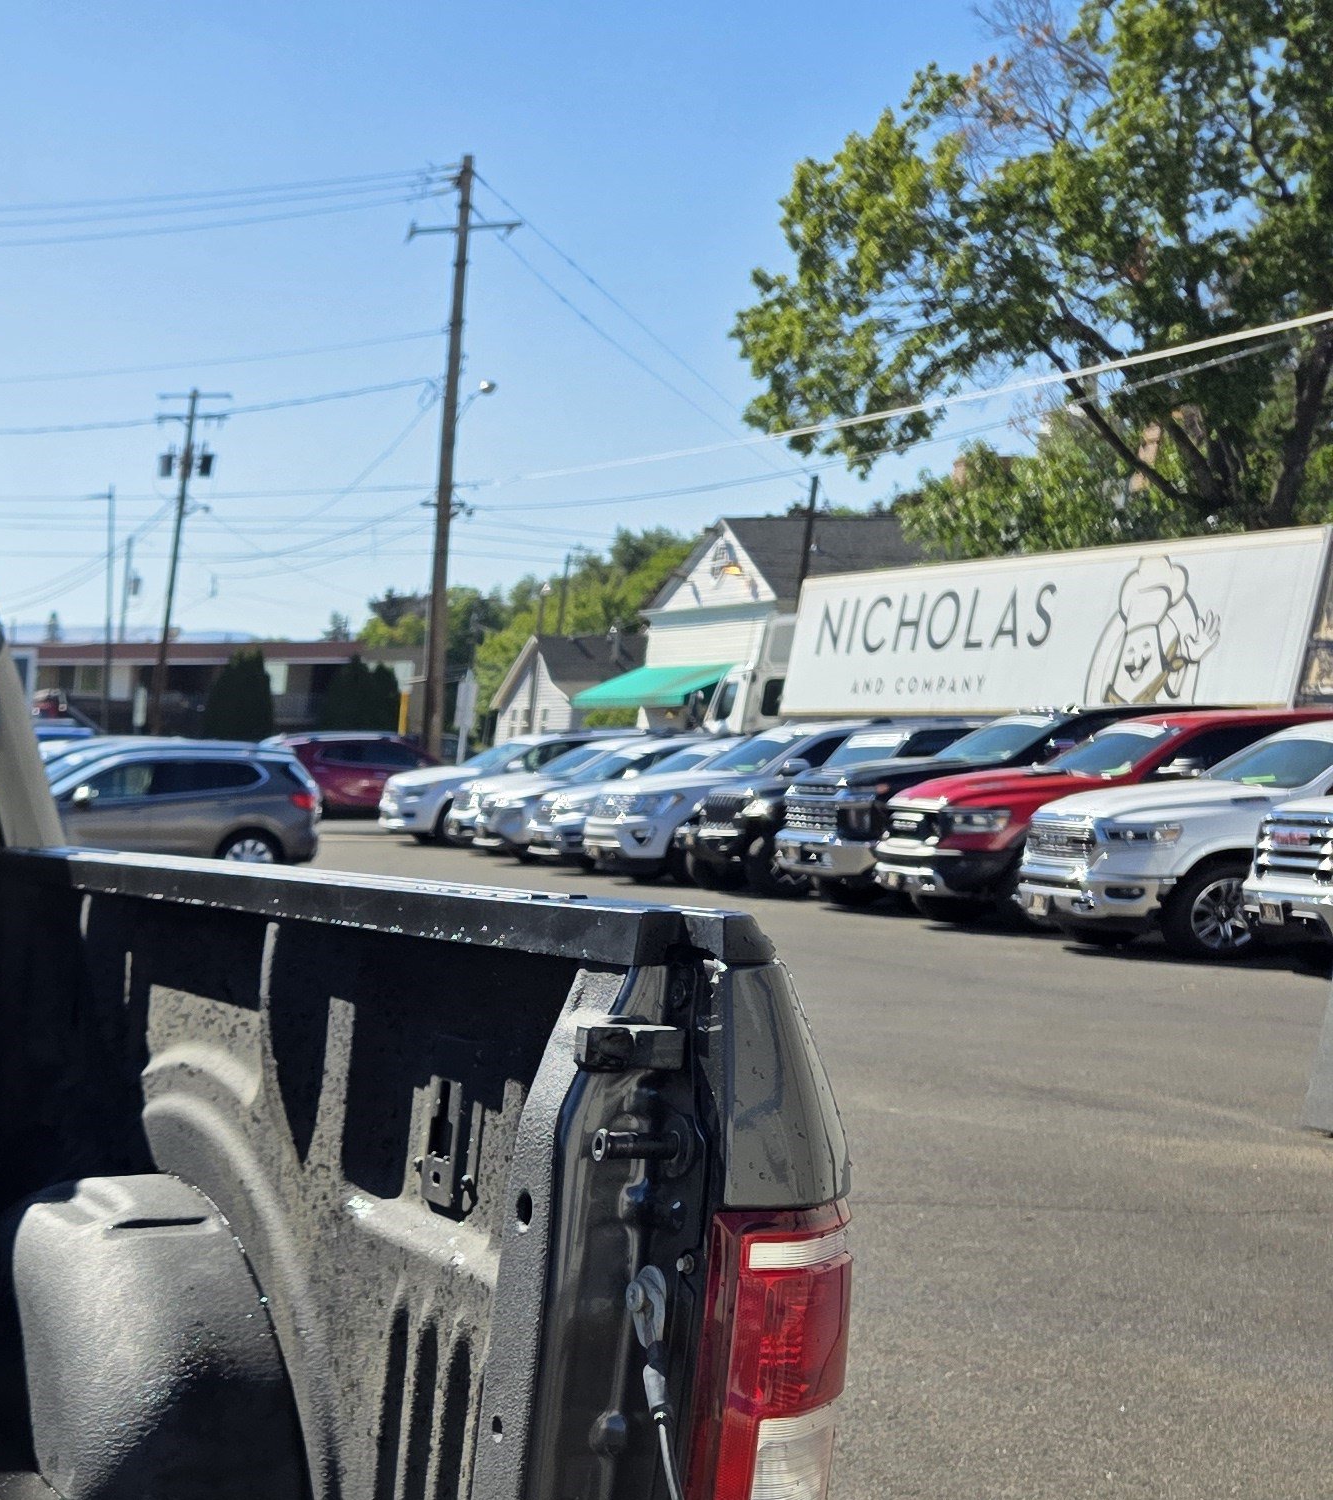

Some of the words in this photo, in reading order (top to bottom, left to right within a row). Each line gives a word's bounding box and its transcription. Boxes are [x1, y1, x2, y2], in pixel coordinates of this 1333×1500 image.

[814, 581, 1058, 656] NICHOLAS
[850, 677, 885, 695] AND
[894, 674, 987, 695] COMPANY
